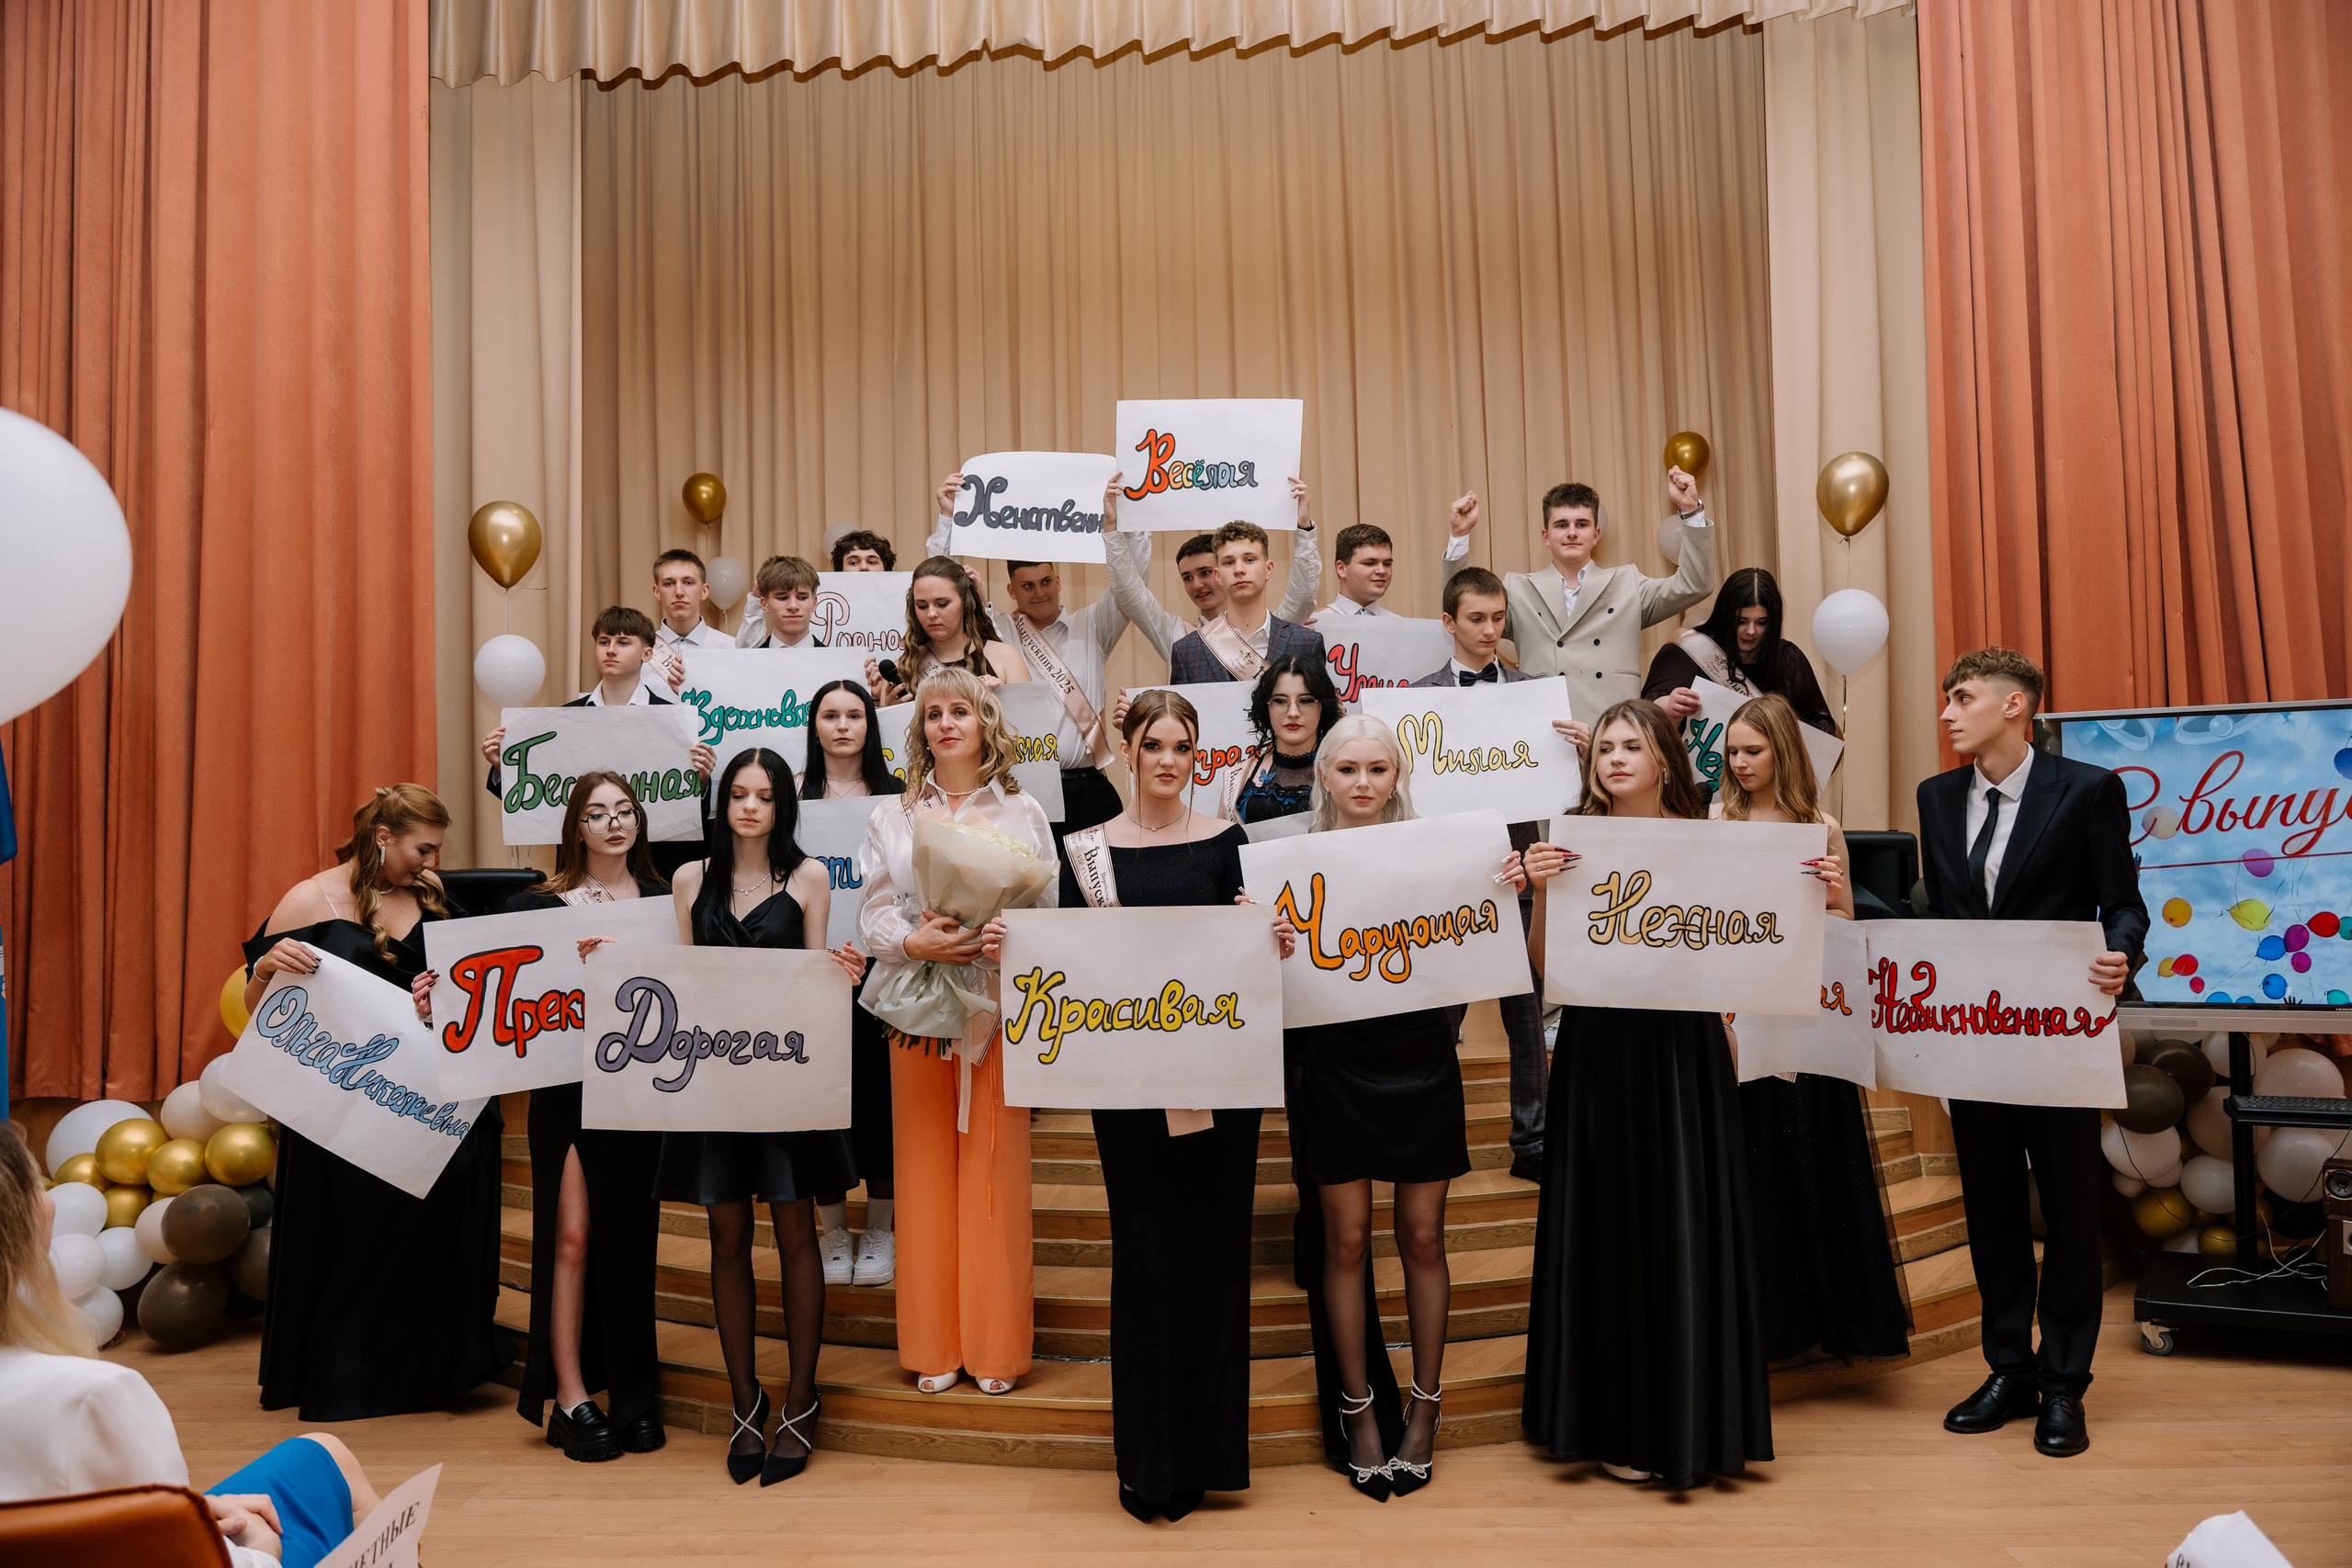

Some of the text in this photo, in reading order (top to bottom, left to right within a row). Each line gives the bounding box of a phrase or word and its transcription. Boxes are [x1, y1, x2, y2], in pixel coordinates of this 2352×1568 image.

[1124, 429, 1258, 501] Весёлая
[1051, 668, 1075, 694] 2025
[1397, 711, 1538, 775] Милая
[1084, 845, 1106, 908] Выпуск
[1589, 870, 1783, 950] Нежная
[1274, 872, 1498, 984] Чарующая
[256, 986, 340, 1075] Ольга
[442, 945, 585, 1058] Прек
[595, 976, 809, 1092] Дорогая
[1006, 966, 1245, 1065] Красивая
